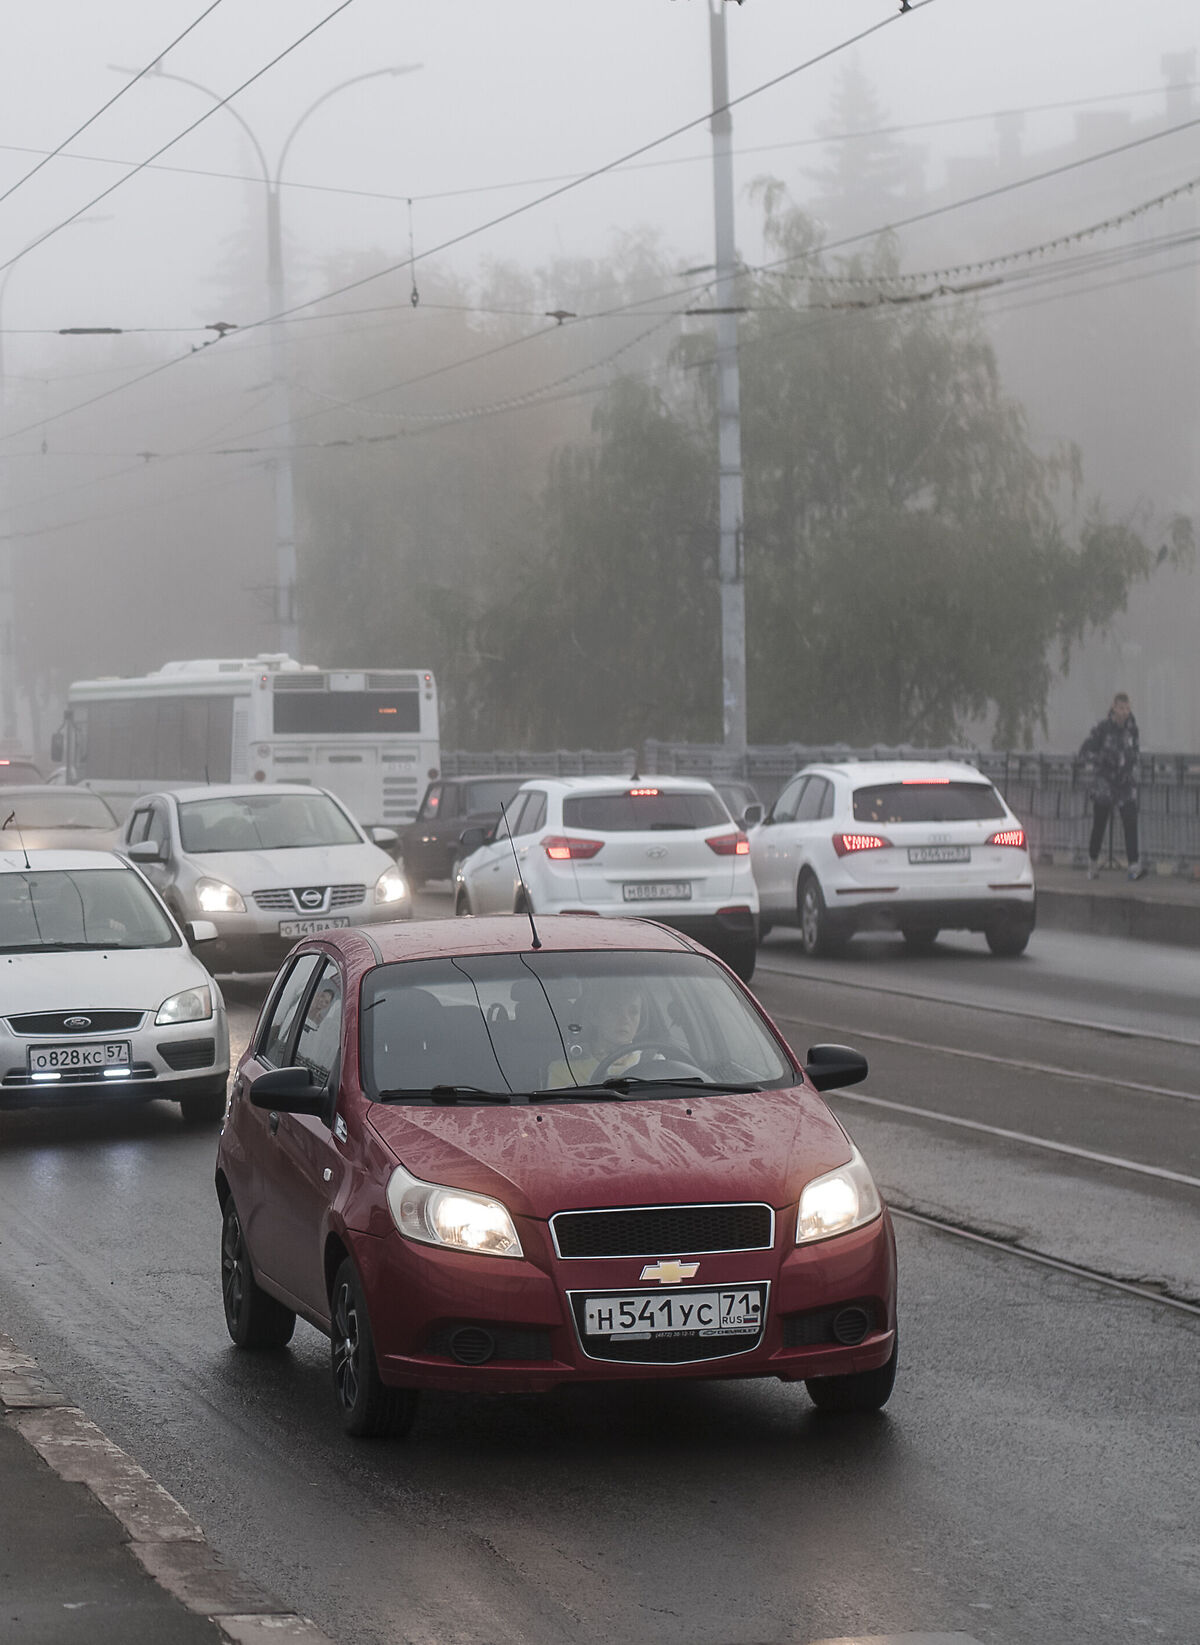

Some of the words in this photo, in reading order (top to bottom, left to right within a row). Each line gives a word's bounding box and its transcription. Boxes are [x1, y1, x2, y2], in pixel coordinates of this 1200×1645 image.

[37, 1050, 102, 1067] О828КС
[107, 1045, 122, 1058] 57
[597, 1299, 713, 1330] Н541УС
[722, 1293, 750, 1316] 71
[722, 1315, 743, 1324] RUS
